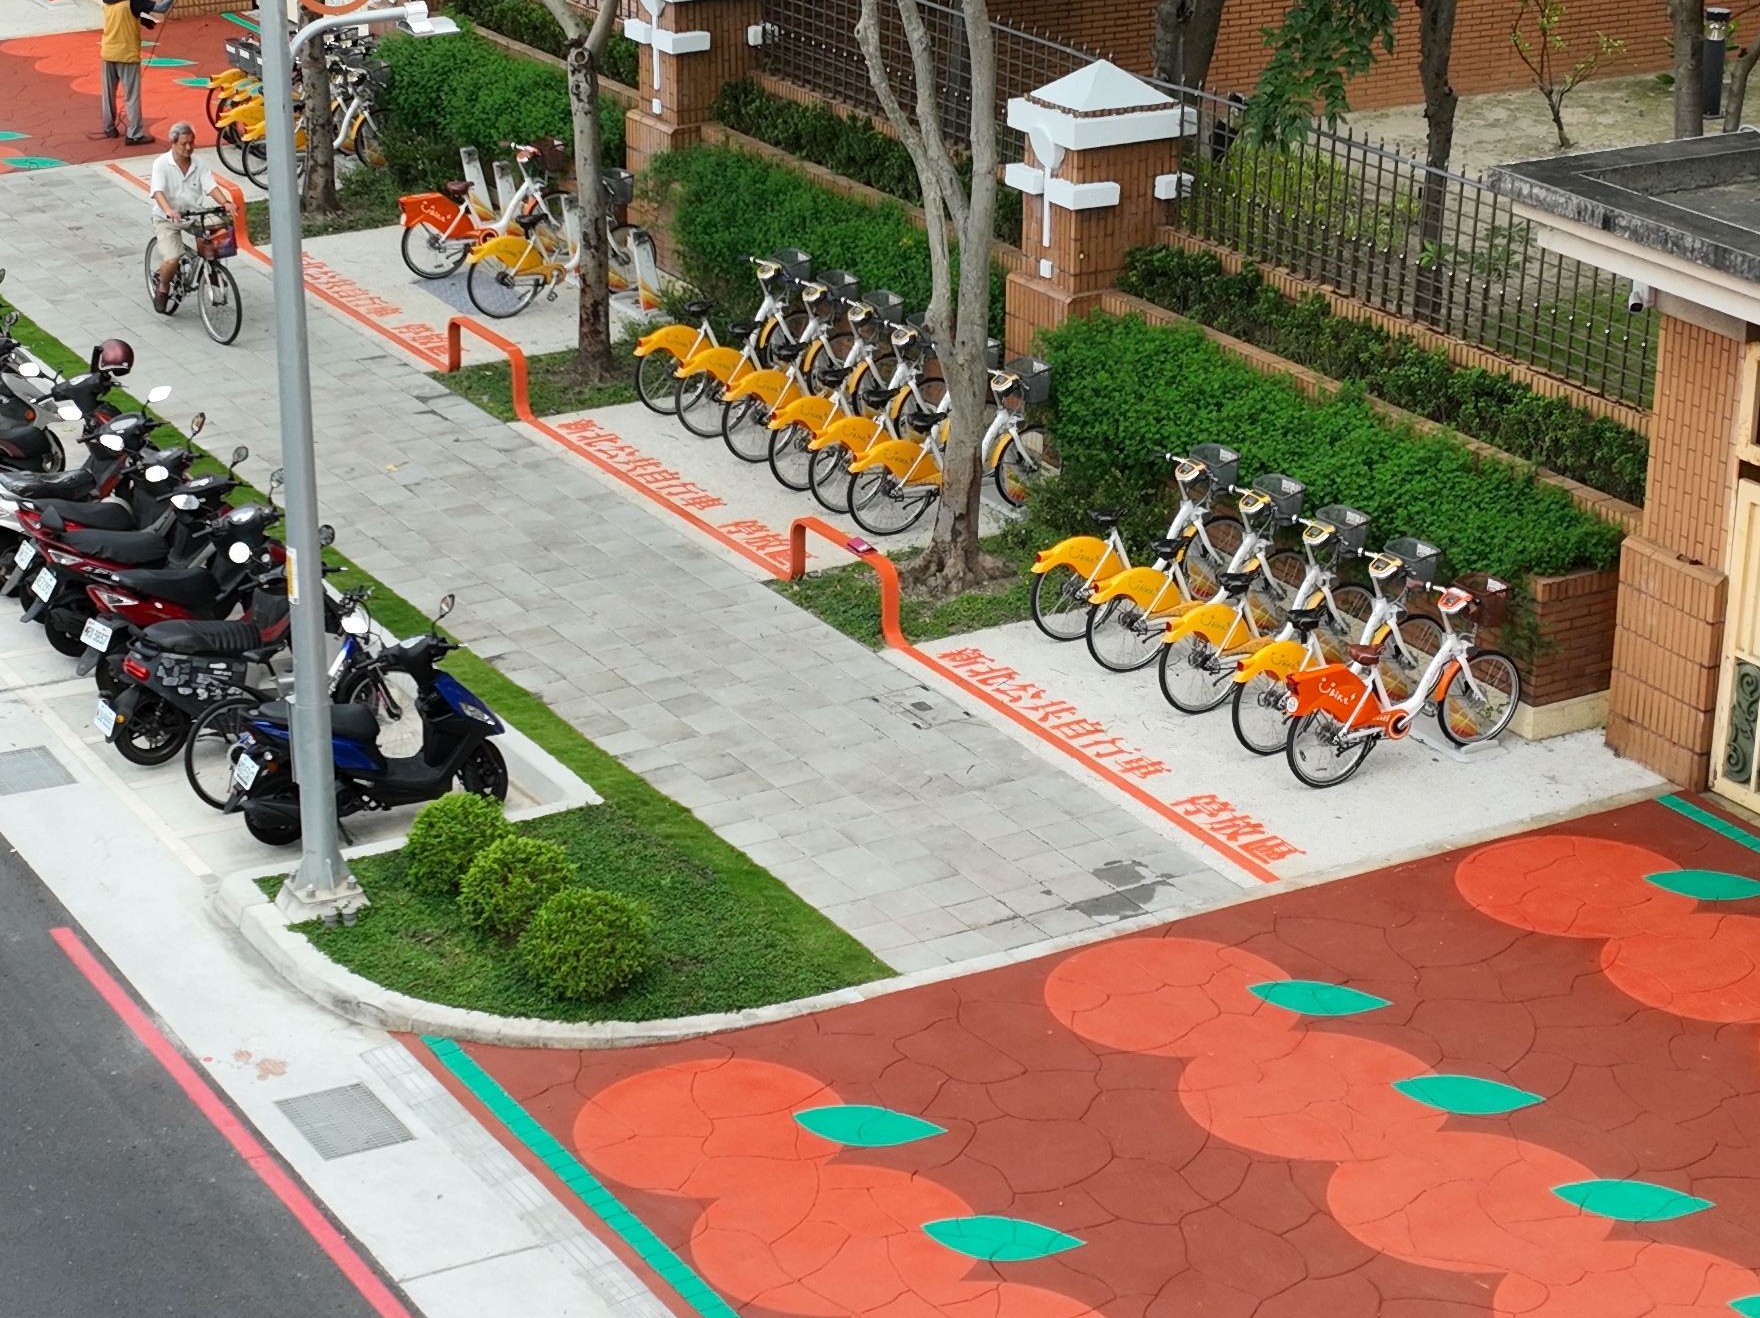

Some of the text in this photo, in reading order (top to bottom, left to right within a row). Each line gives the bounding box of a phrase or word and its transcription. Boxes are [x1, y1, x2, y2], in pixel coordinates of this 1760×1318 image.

[557, 419, 728, 510] 新北公共自行車
[936, 647, 1307, 865] 新北公共自行車 停放區
